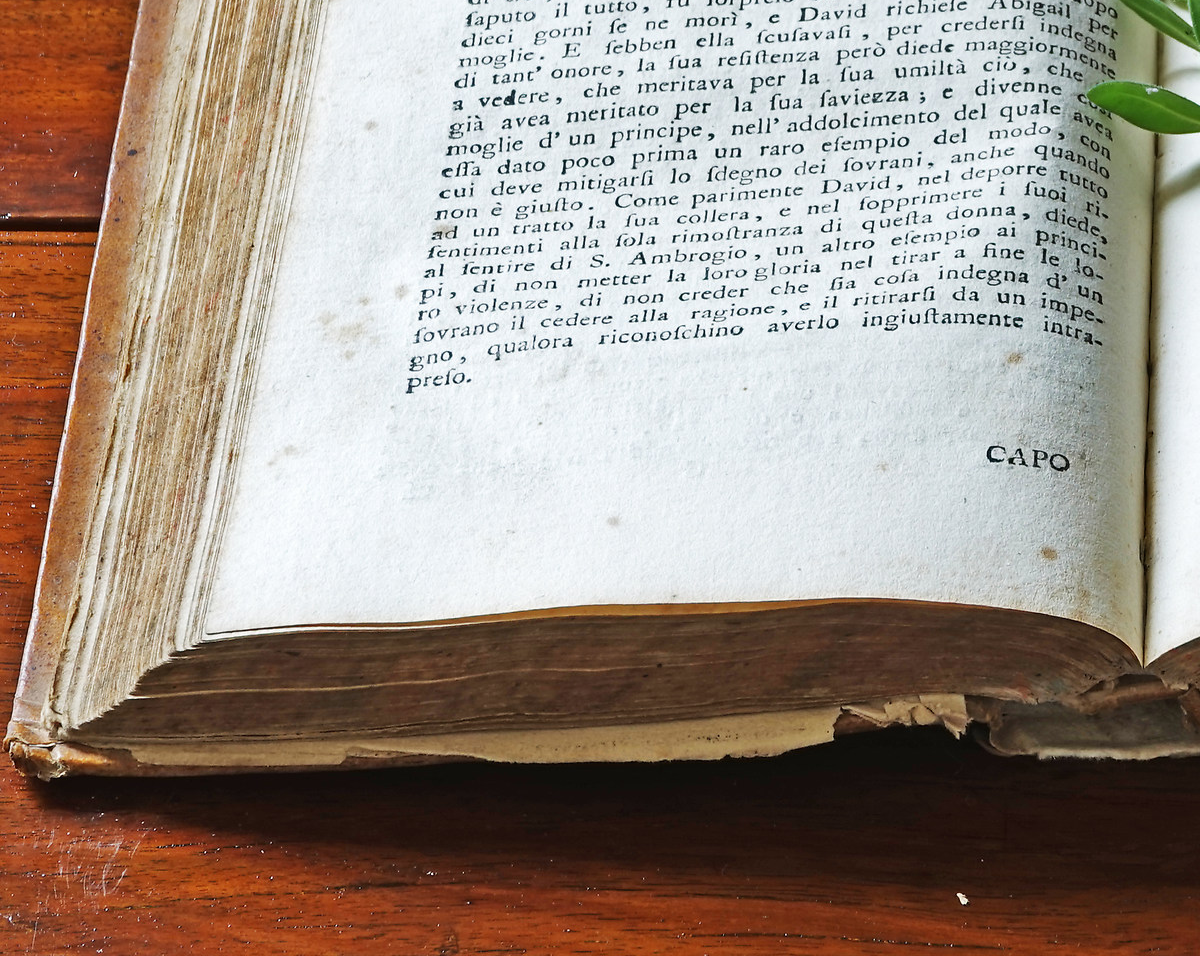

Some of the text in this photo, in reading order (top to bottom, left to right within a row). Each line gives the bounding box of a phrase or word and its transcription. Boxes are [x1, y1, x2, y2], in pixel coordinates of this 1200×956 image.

[534, 21, 591, 46] gorni
[799, 4, 866, 22] David
[696, 20, 1117, 61] ella indegna
[638, 59, 966, 93] meritava umiltà
[836, 38, 1116, 80] però diede maggiormente
[567, 78, 1061, 123] meritato divenne
[446, 111, 1113, 159] moglie addolcimento avea
[491, 143, 1110, 195] deve anche quando
[498, 145, 697, 177] dato poco prima
[615, 165, 1110, 208] Come deporre tutto
[513, 222, 573, 234] tratto
[822, 228, 1107, 261] altro princi-
[578, 260, 820, 288] metter gloria
[939, 264, 1029, 286] indegna
[488, 315, 839, 361] qualora averlo
[541, 313, 613, 328] cedere
[986, 445, 1070, 472] CAPO
